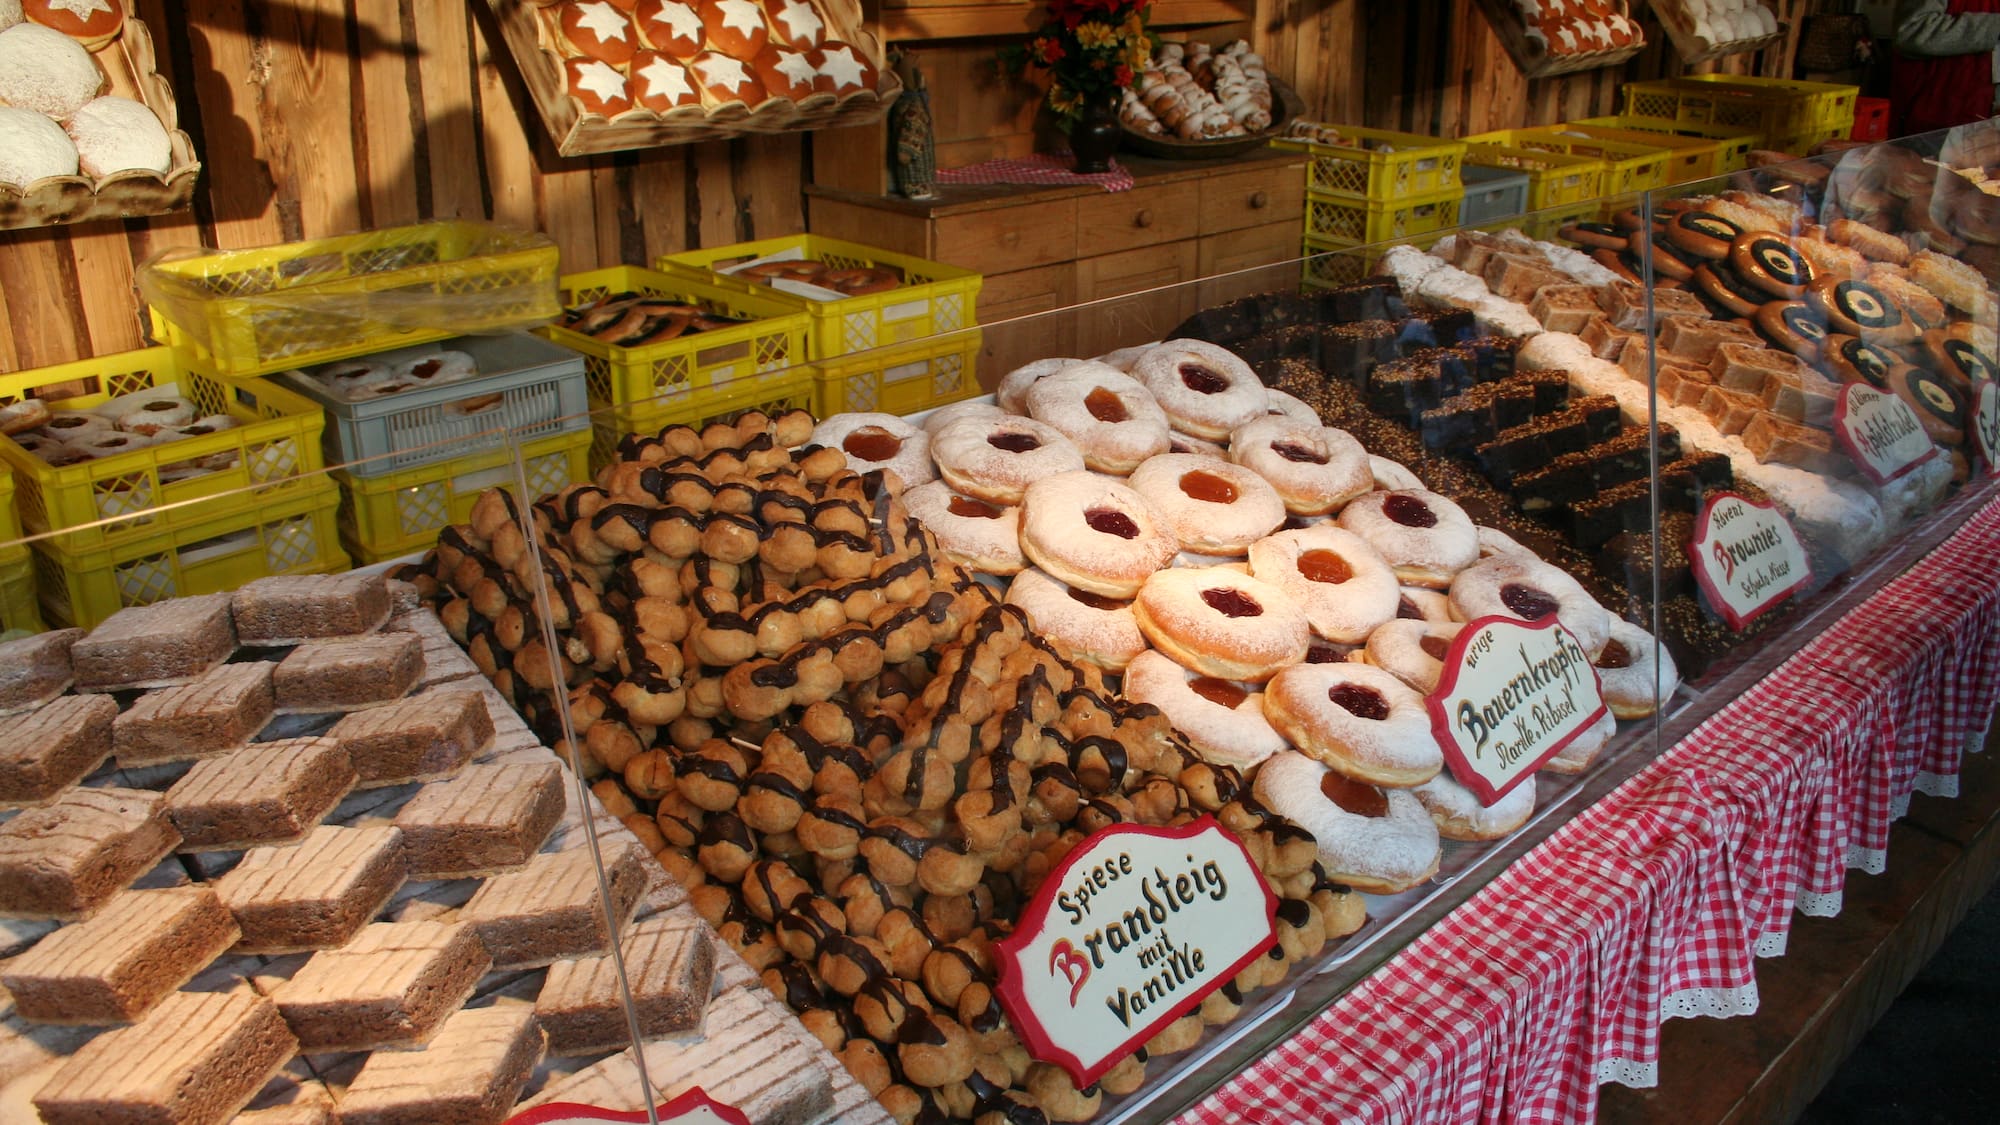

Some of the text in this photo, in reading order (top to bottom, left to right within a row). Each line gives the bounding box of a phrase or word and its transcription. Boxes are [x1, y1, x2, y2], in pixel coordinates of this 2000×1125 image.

[1712, 501, 1744, 530] Advent
[1712, 521, 1782, 586] Brownies
[1466, 630, 1494, 669] urige
[1532, 683, 1577, 736] Ribisel
[1057, 852, 1132, 925] Spiese
[1049, 853, 1228, 1008] Brandteig
[1137, 928, 1174, 969] mit
[1105, 942, 1206, 1029] Vanille
